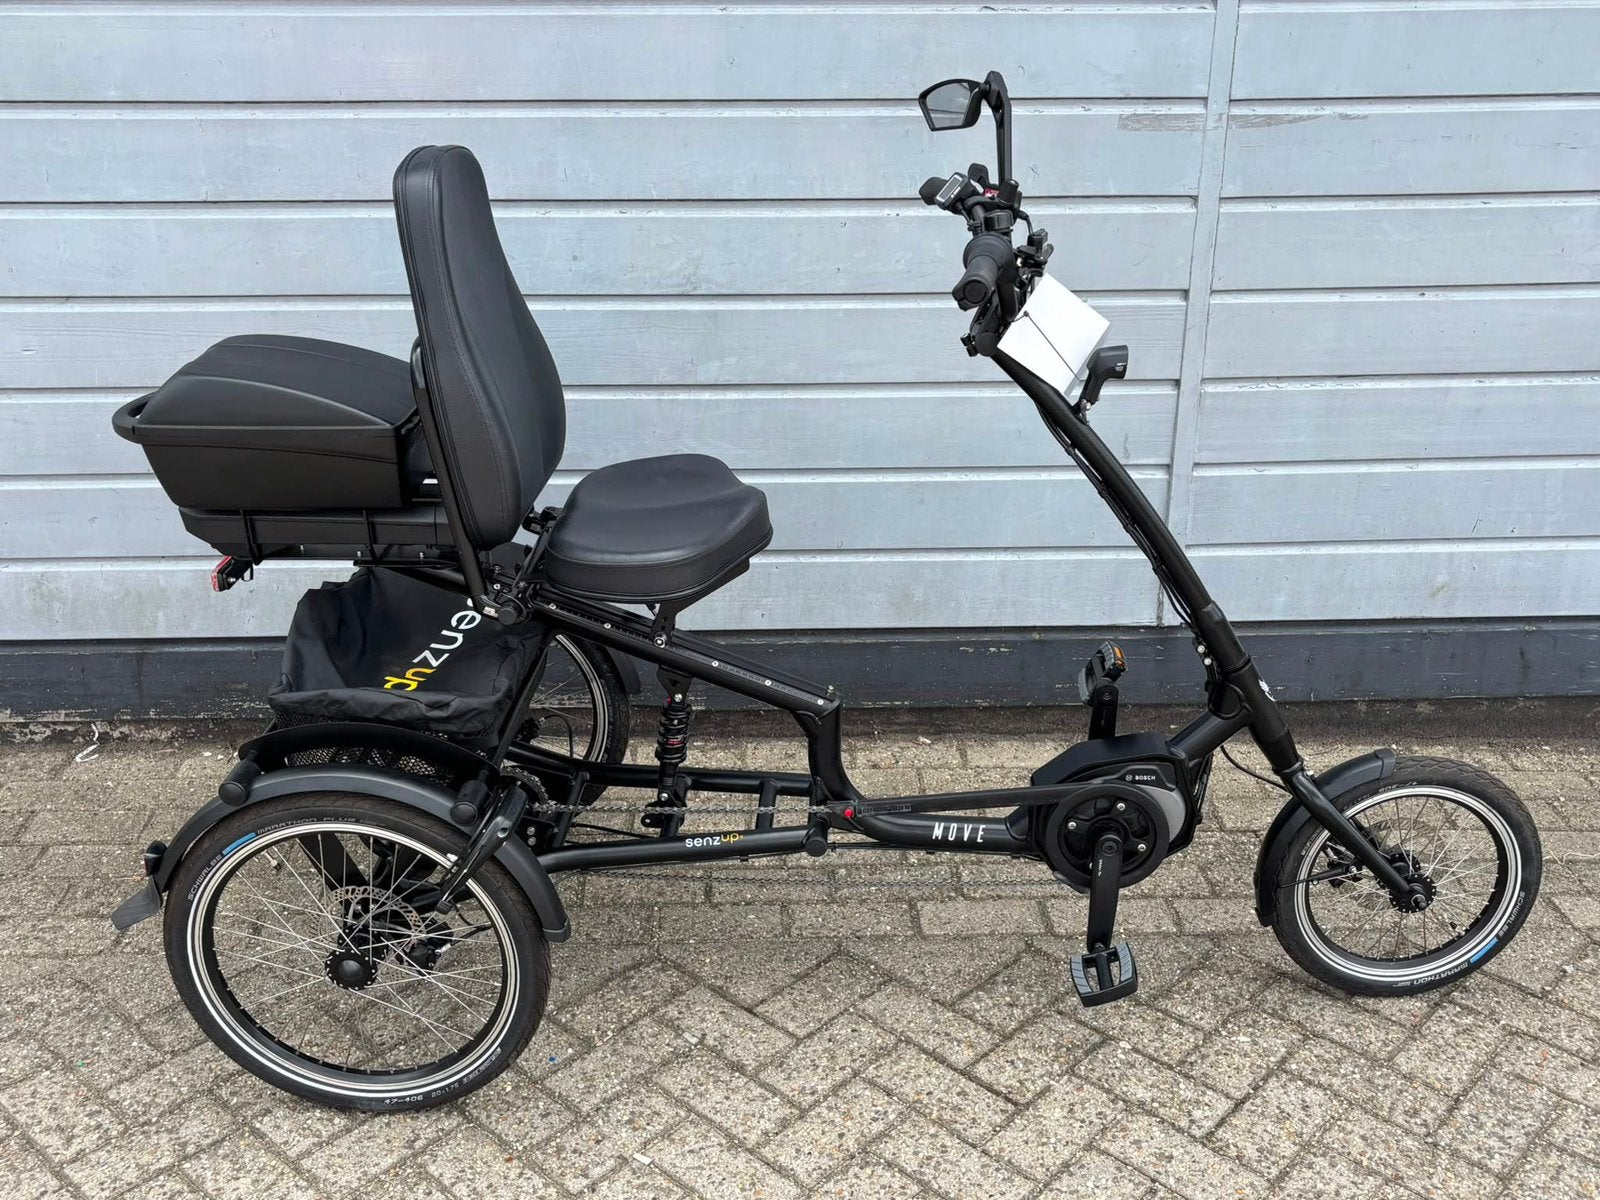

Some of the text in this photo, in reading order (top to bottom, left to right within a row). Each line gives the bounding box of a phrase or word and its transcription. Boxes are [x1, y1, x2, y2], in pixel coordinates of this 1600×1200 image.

[383, 597, 482, 691] enzup
[685, 832, 740, 848] senzup
[932, 821, 987, 843] MOVE
[187, 854, 223, 902] SCHWALBE
[257, 817, 318, 834] MARATHON
[1413, 890, 1526, 985] SCHWALBE MARATHON
[383, 1094, 424, 1105] 47-406
